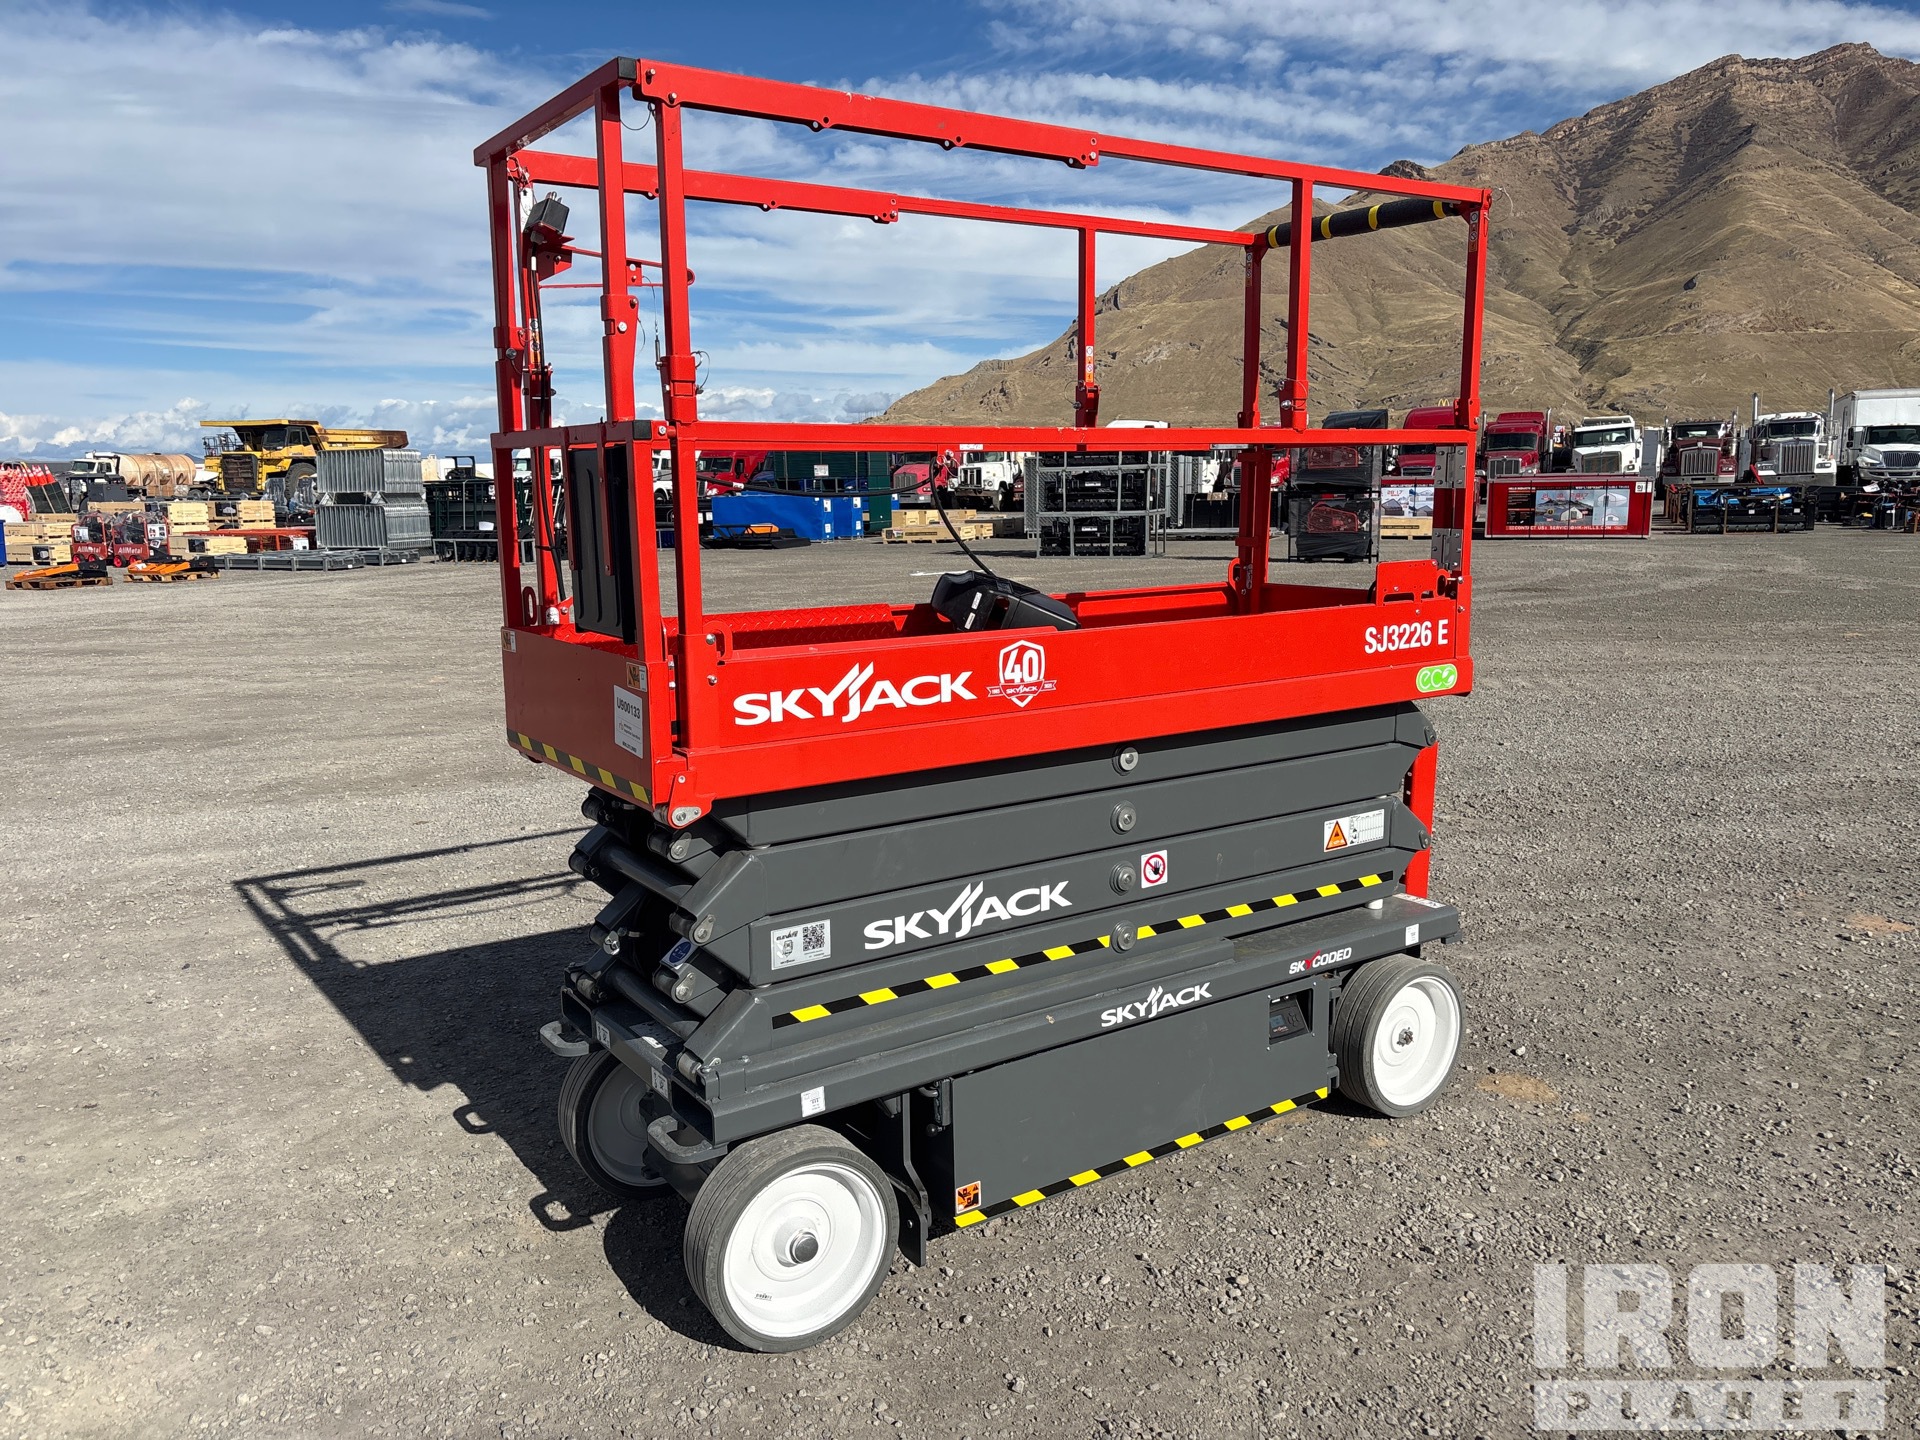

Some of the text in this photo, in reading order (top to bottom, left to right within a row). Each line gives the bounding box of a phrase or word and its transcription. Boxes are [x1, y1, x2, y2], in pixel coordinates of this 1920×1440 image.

[77, 545, 101, 553] AllMtal
[1364, 619, 1449, 654] SJ3226 E
[1004, 648, 1039, 684] 40
[1419, 666, 1455, 690] eco
[616, 697, 641, 719] U900133
[733, 661, 978, 726] SKYJACK
[863, 880, 1073, 950] SKYJACK
[1289, 948, 1352, 974] SKYCODED
[1100, 982, 1213, 1028] SKYJACK
